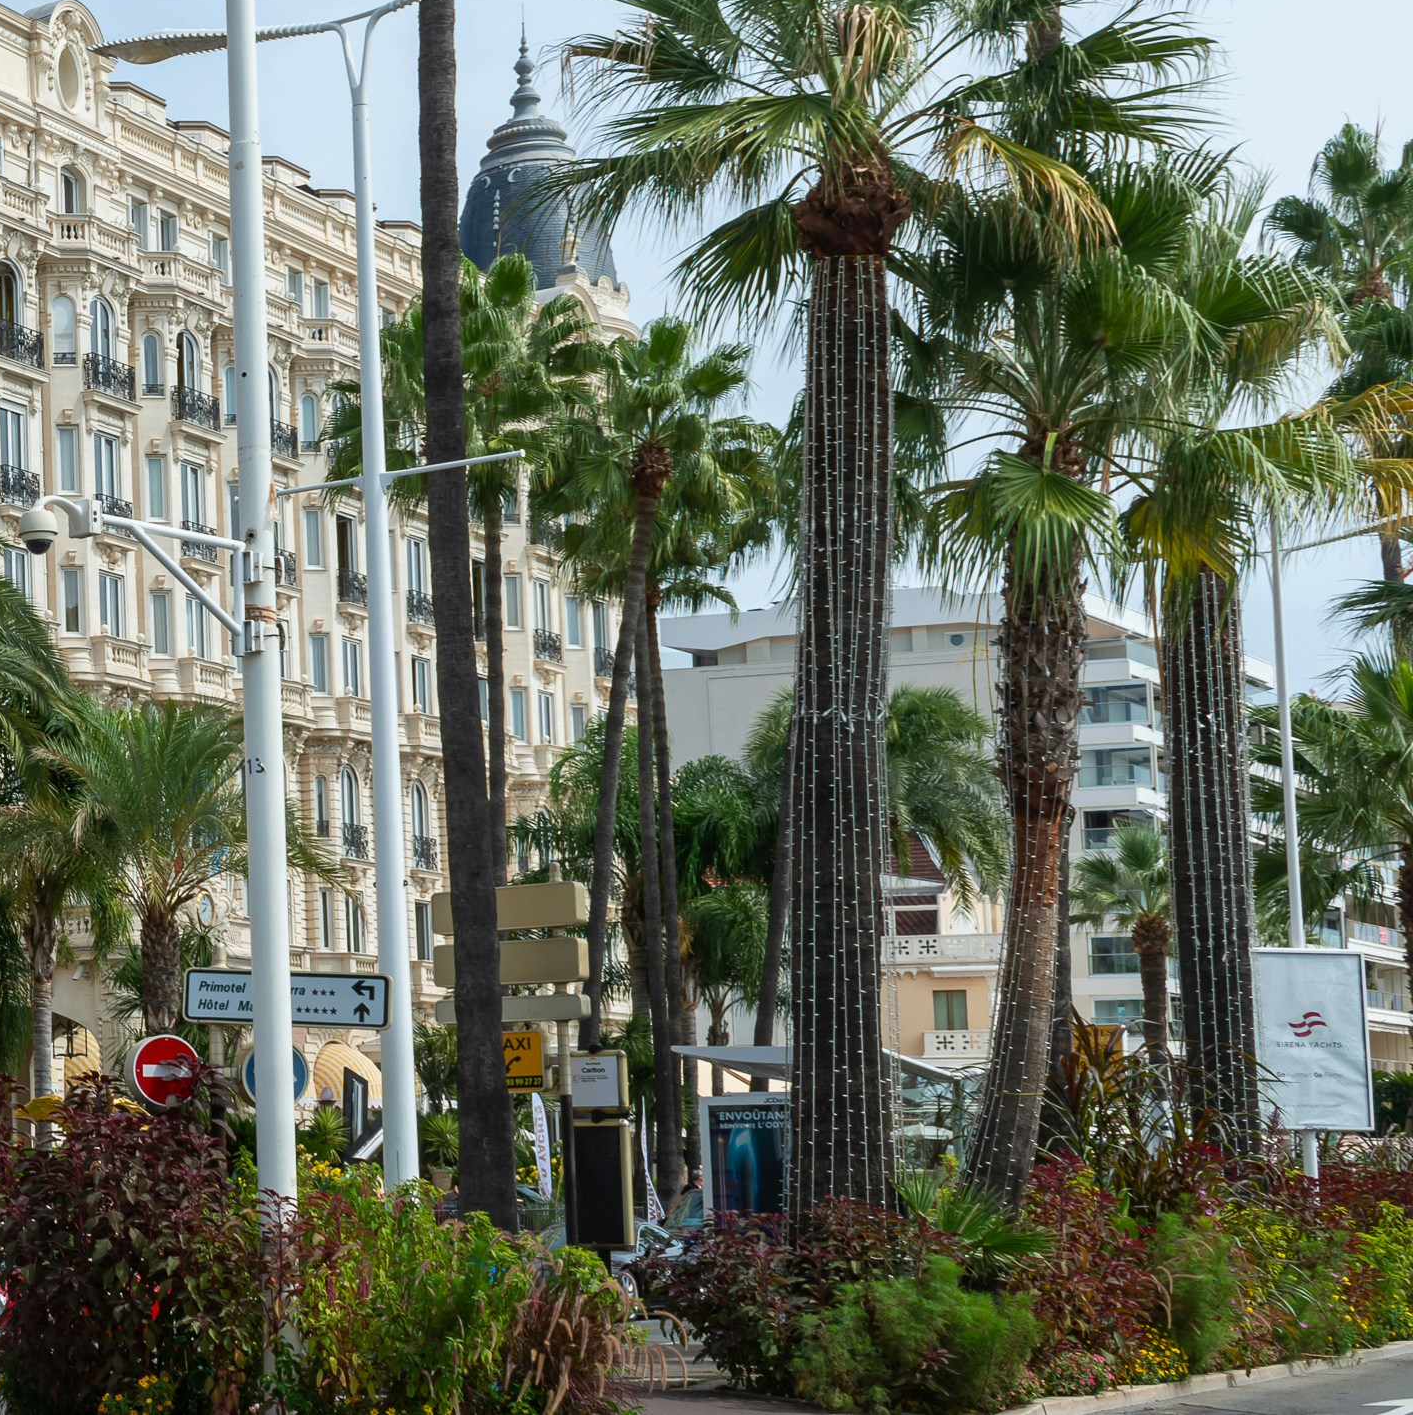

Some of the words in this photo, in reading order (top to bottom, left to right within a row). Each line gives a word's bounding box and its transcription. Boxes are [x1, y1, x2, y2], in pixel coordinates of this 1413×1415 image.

[198, 980, 246, 994] Primotel
[197, 998, 230, 1011] Hôtel
[503, 1037, 531, 1050] AXI
[524, 1077, 532, 1085] 27
[533, 1077, 542, 1085] 27
